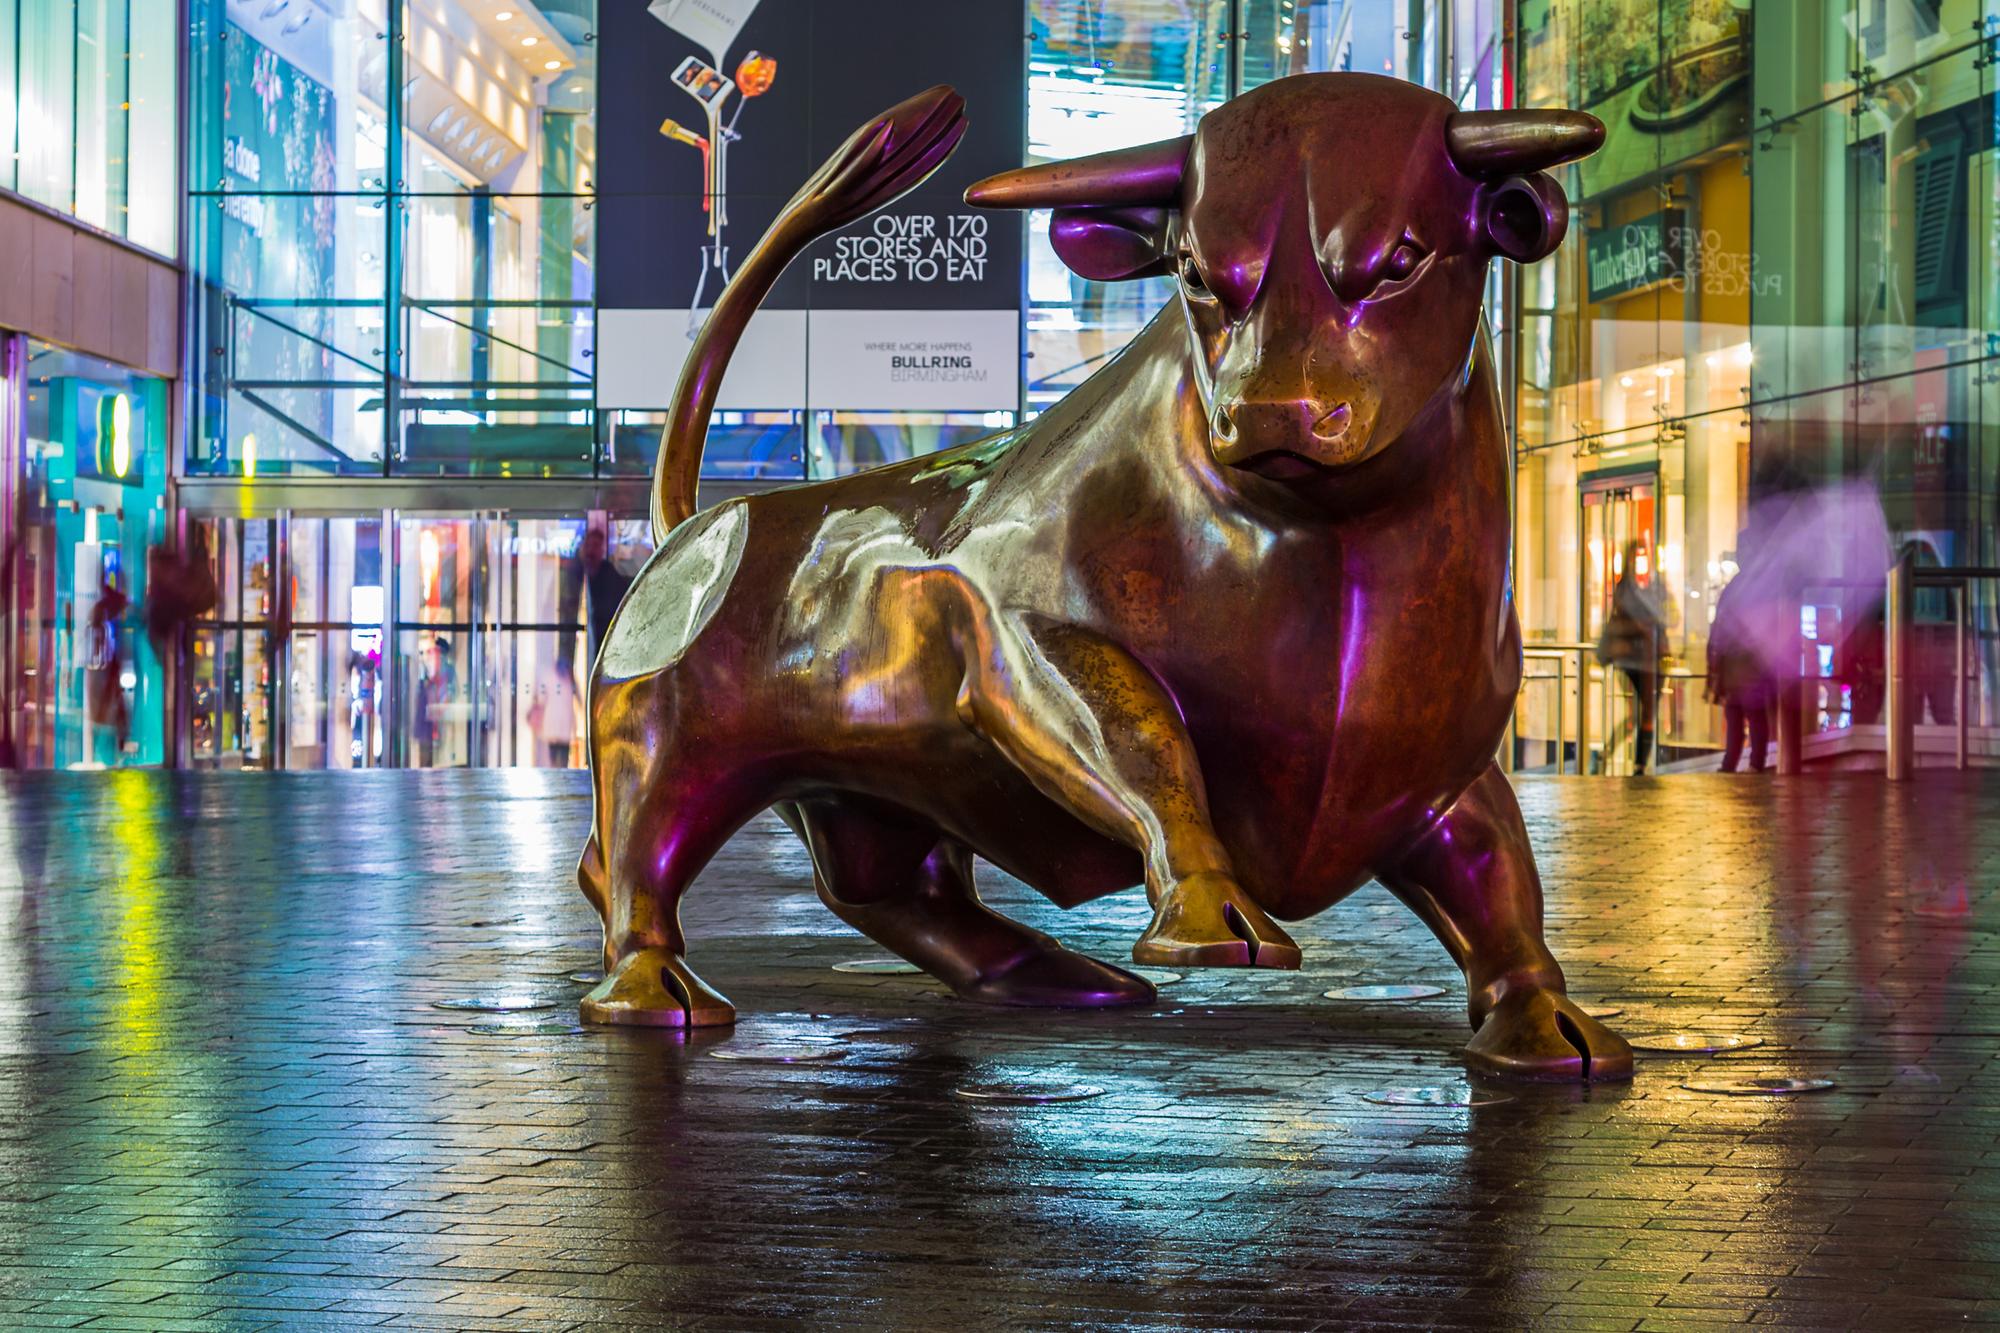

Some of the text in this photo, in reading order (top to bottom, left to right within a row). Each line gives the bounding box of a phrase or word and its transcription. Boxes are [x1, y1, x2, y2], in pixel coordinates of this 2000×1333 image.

[873, 215, 988, 238] OVER 170
[835, 236, 987, 260] STORES AND
[814, 258, 988, 281] PLACES TO EAT
[864, 341, 972, 352] WHERE MORE HAPPENS
[892, 355, 972, 368] BULLRING
[891, 369, 987, 382] BIRMINGHAM
